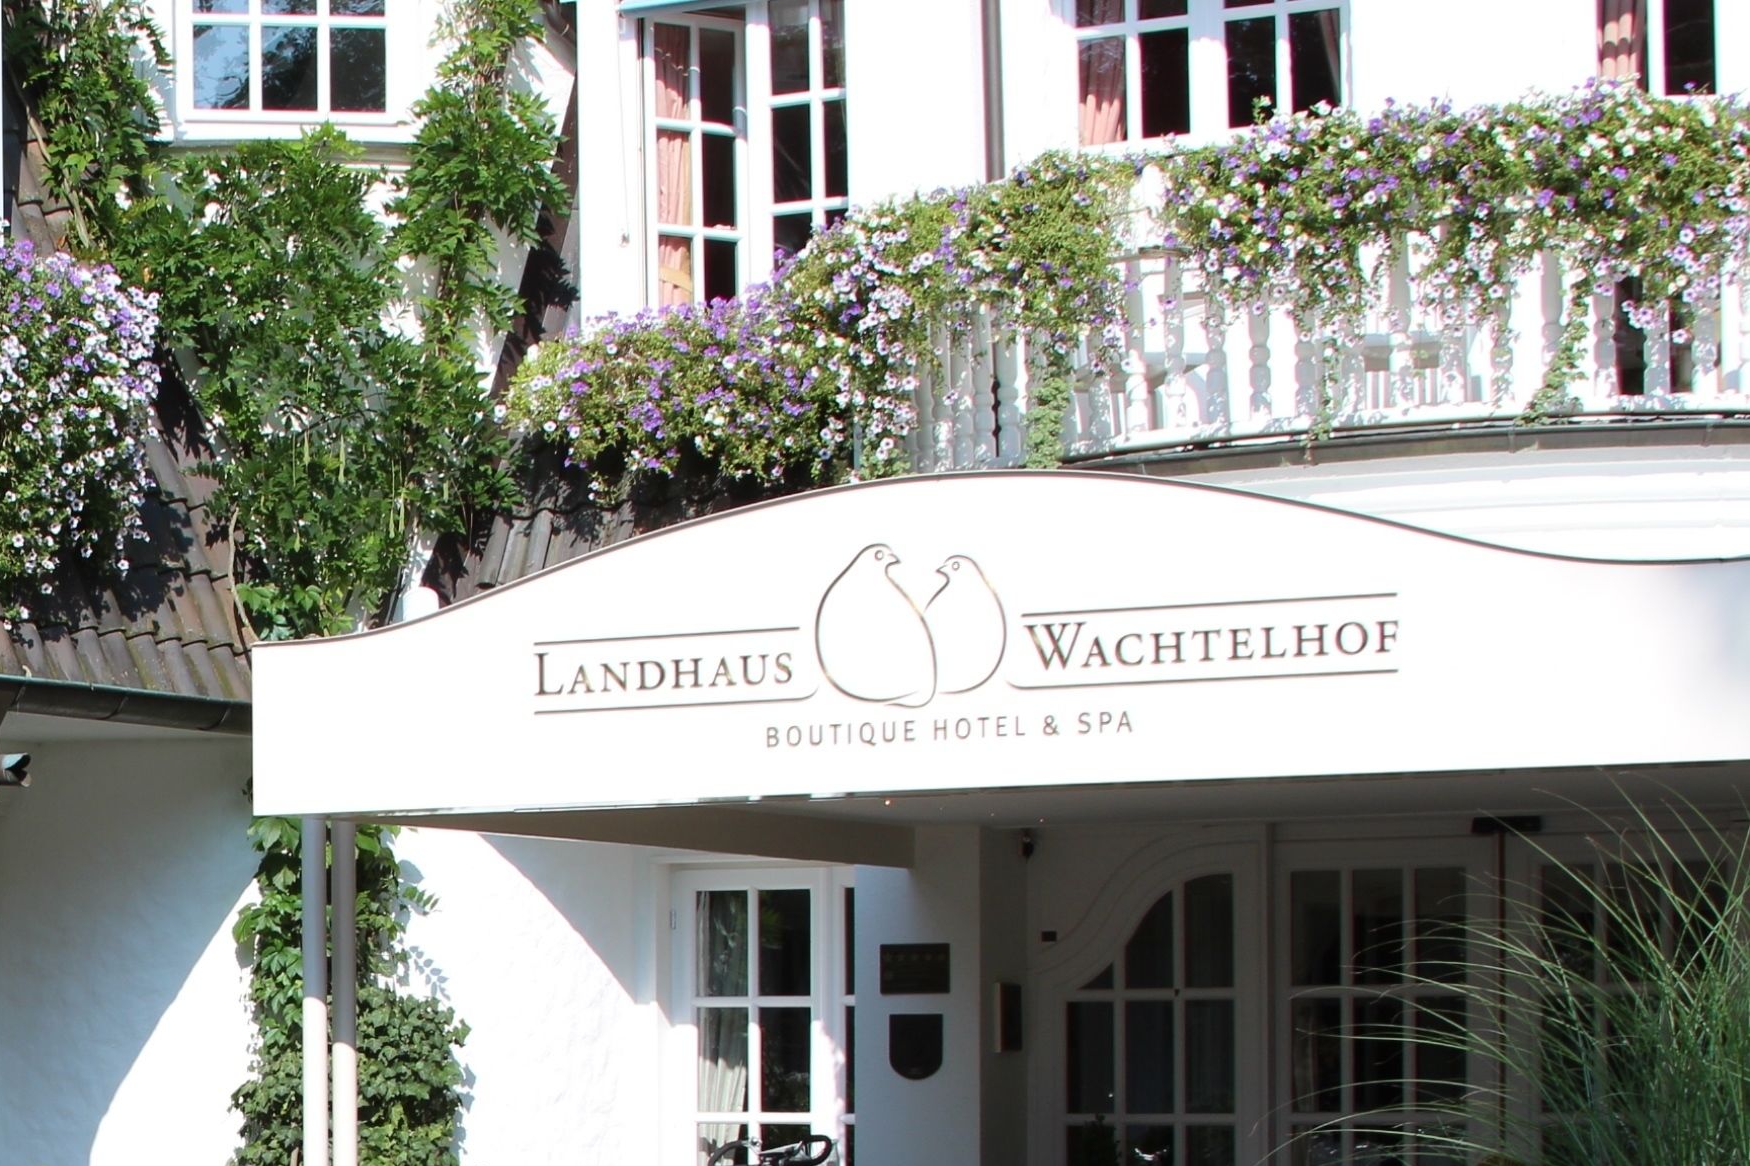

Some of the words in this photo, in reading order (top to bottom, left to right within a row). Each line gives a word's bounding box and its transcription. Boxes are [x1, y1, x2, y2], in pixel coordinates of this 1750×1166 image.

[534, 652, 793, 697] LANDHAUS
[1023, 620, 1399, 671] WACHTELHOF
[766, 720, 916, 748] BOUTIQUE
[932, 716, 1026, 742] HOTEL
[1042, 714, 1059, 736] &
[1078, 711, 1133, 735] SPA
